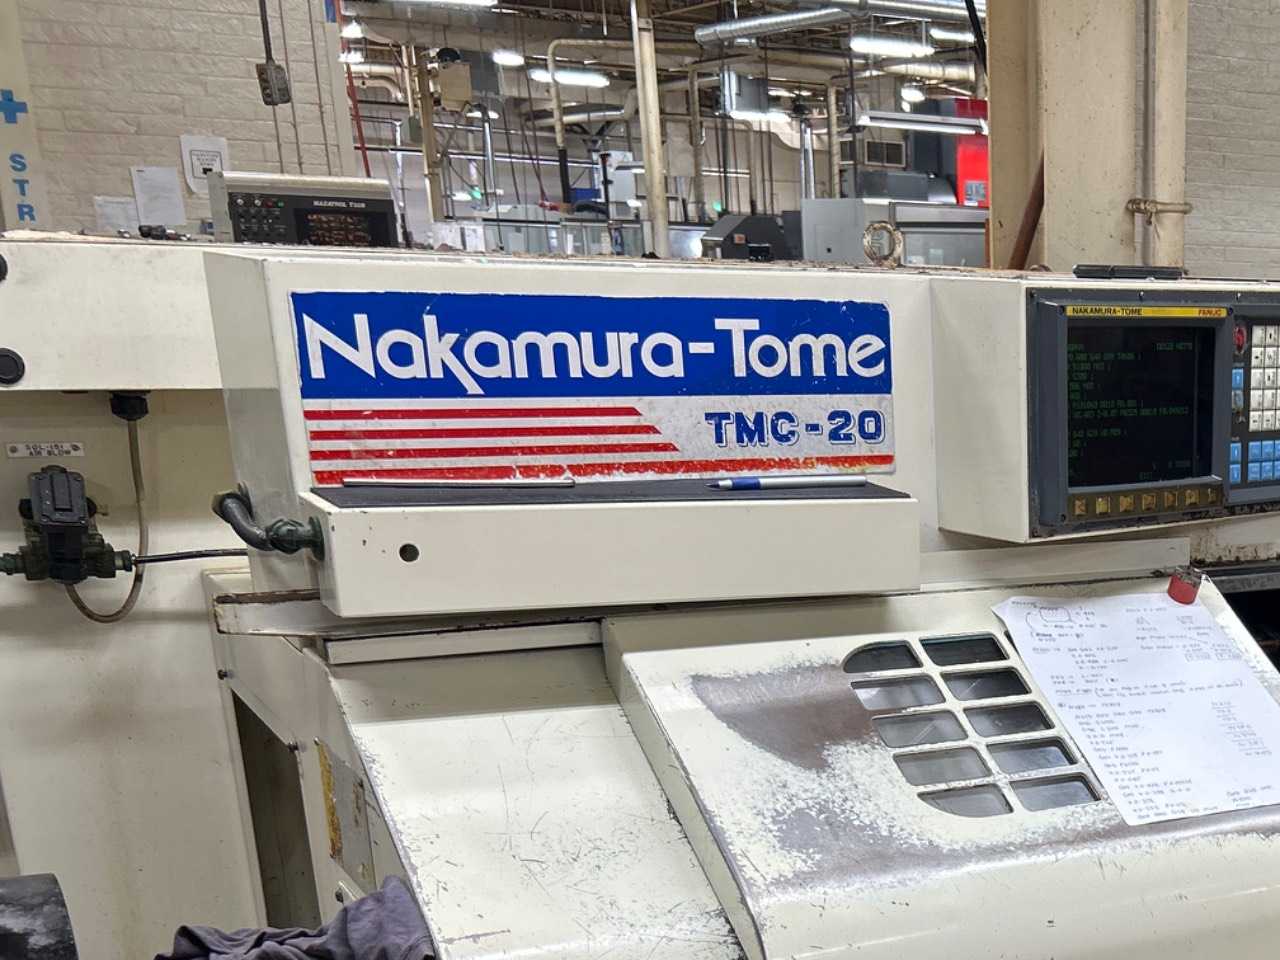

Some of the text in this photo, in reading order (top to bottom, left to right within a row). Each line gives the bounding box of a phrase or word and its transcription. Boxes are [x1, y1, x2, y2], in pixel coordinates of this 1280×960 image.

[1072, 307, 1142, 316] NAKAMURA-TOME
[302, 313, 885, 395] Nakamura-Tome
[704, 409, 886, 447] TMC-20
